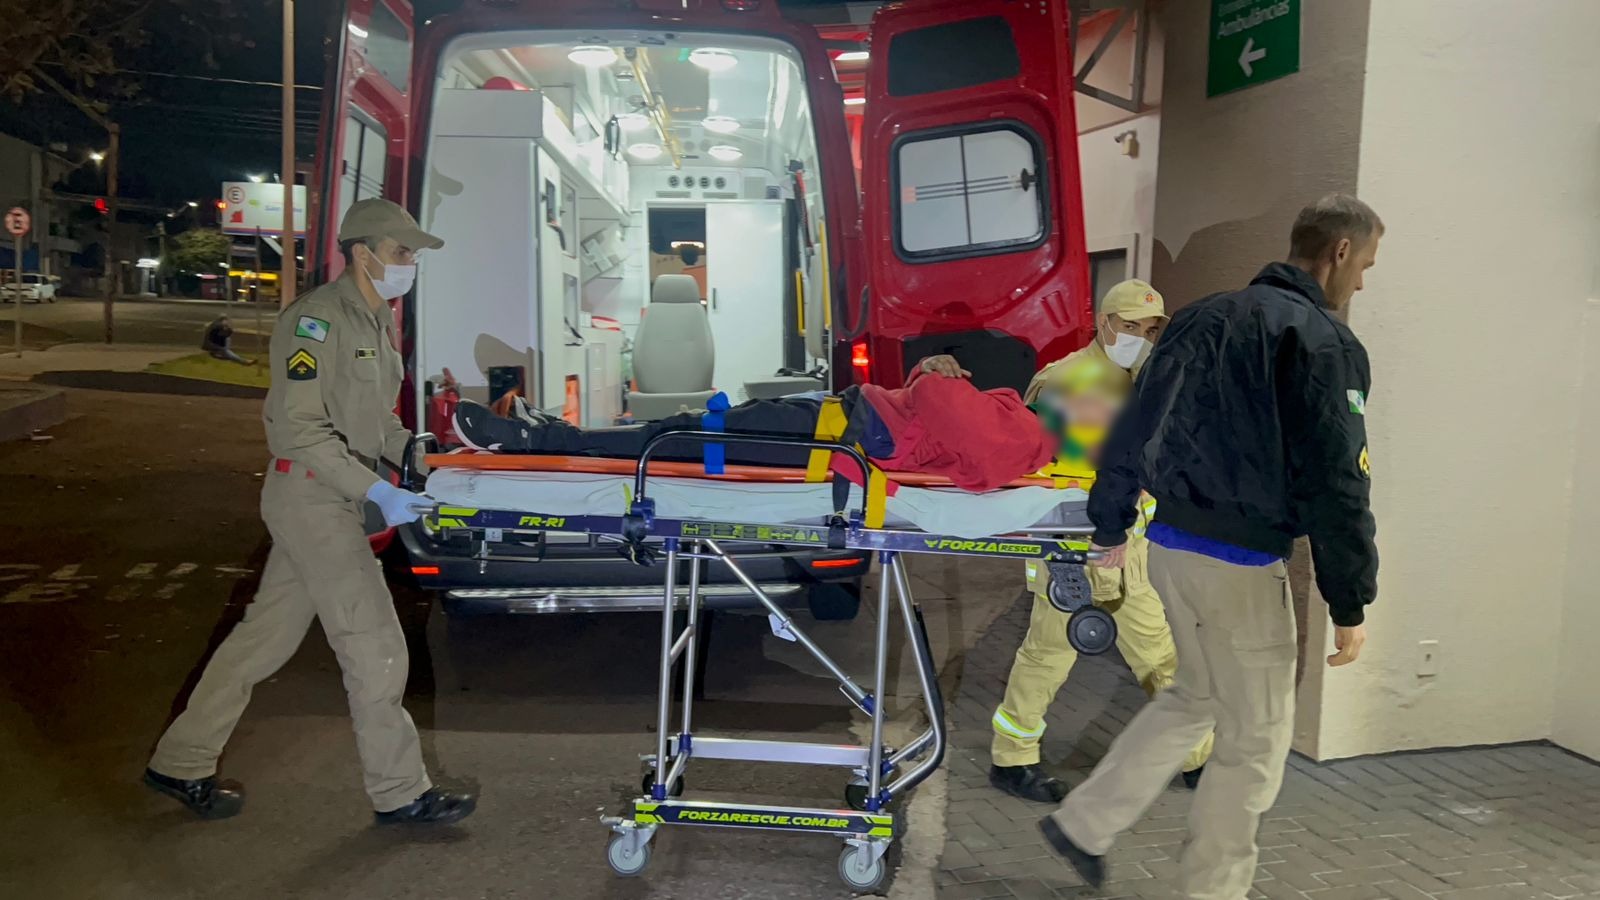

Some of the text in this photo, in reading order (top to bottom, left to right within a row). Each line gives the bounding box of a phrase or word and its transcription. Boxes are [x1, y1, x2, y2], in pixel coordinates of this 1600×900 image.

[938, 539, 1041, 554] FORZA RESCUE
[678, 810, 849, 828] FORZARESCUE.COM.BR
